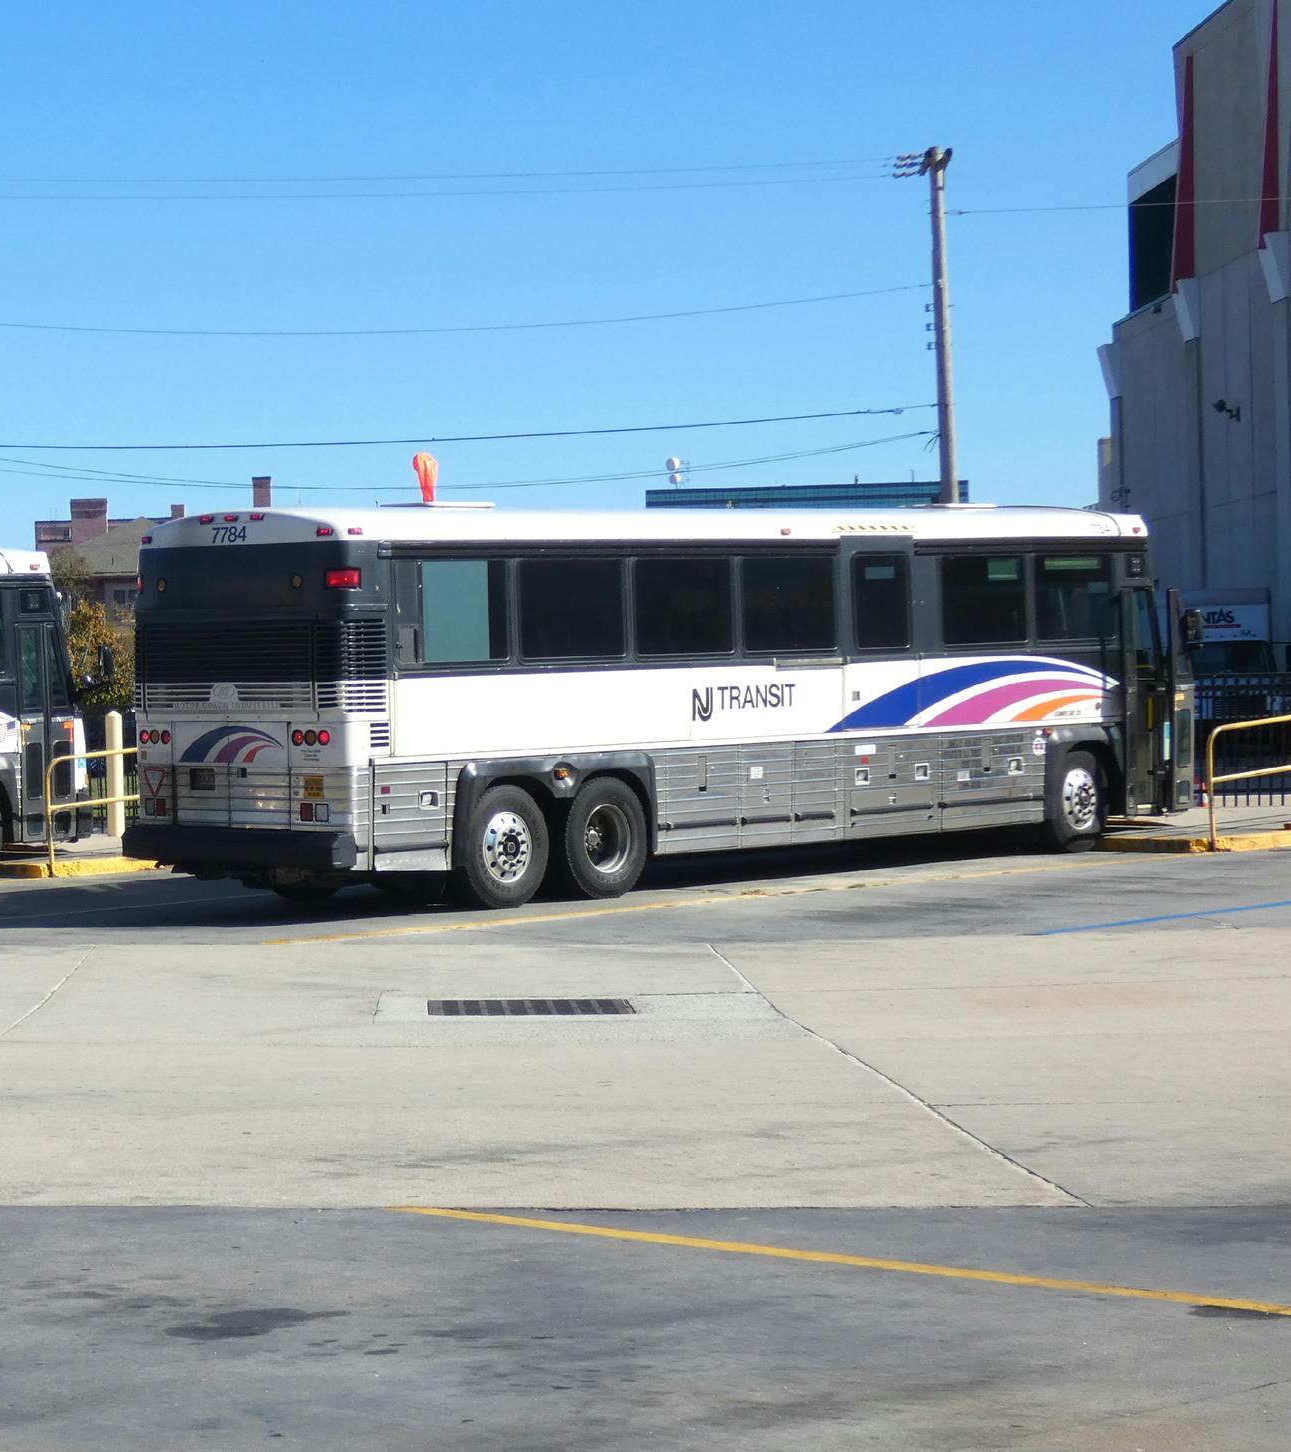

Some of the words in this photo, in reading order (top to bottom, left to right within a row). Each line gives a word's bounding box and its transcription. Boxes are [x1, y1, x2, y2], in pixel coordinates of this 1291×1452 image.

[212, 525, 247, 543] 7784
[692, 686, 714, 722] NJ
[717, 683, 796, 710] TRANSIT
